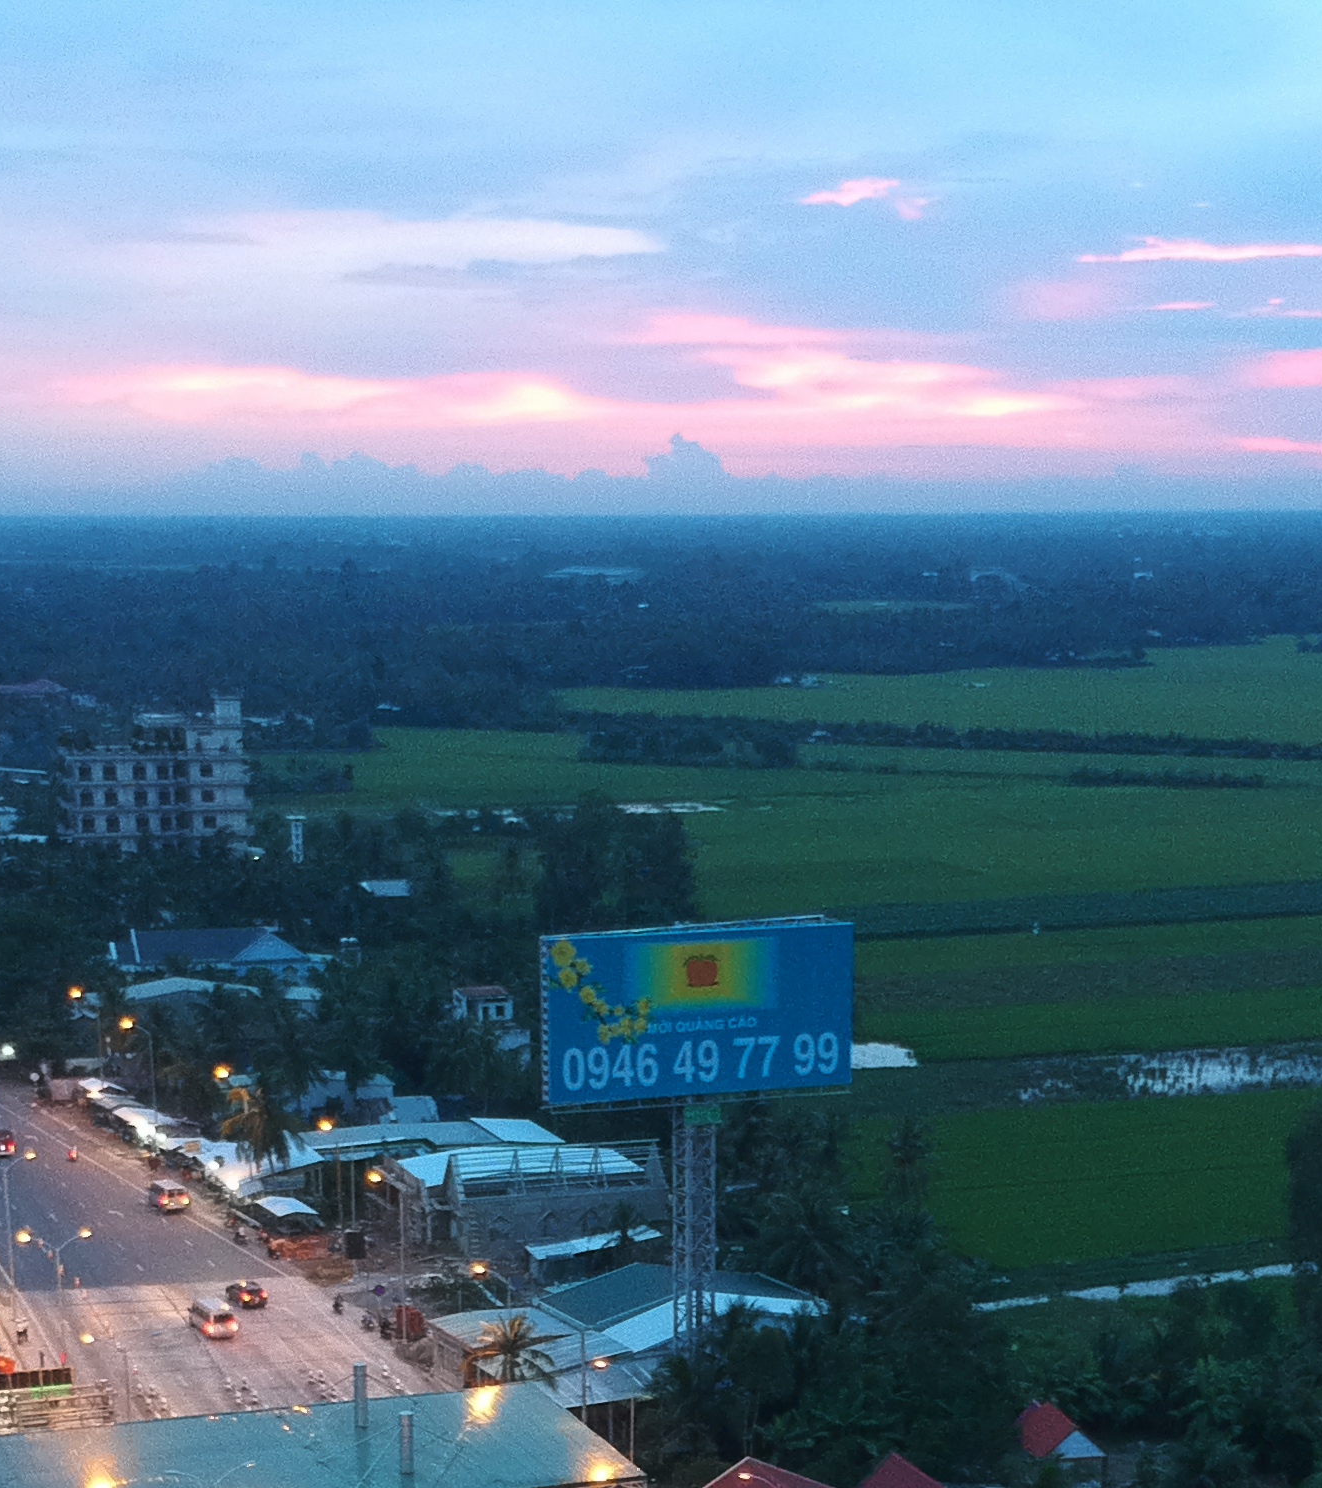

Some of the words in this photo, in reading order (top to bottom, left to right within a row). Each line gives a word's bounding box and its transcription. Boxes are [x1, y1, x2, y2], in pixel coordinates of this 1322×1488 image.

[562, 1043, 659, 1091] 0946
[673, 1039, 720, 1084] 49
[733, 1035, 781, 1079] 77
[793, 1031, 839, 1077] 99
